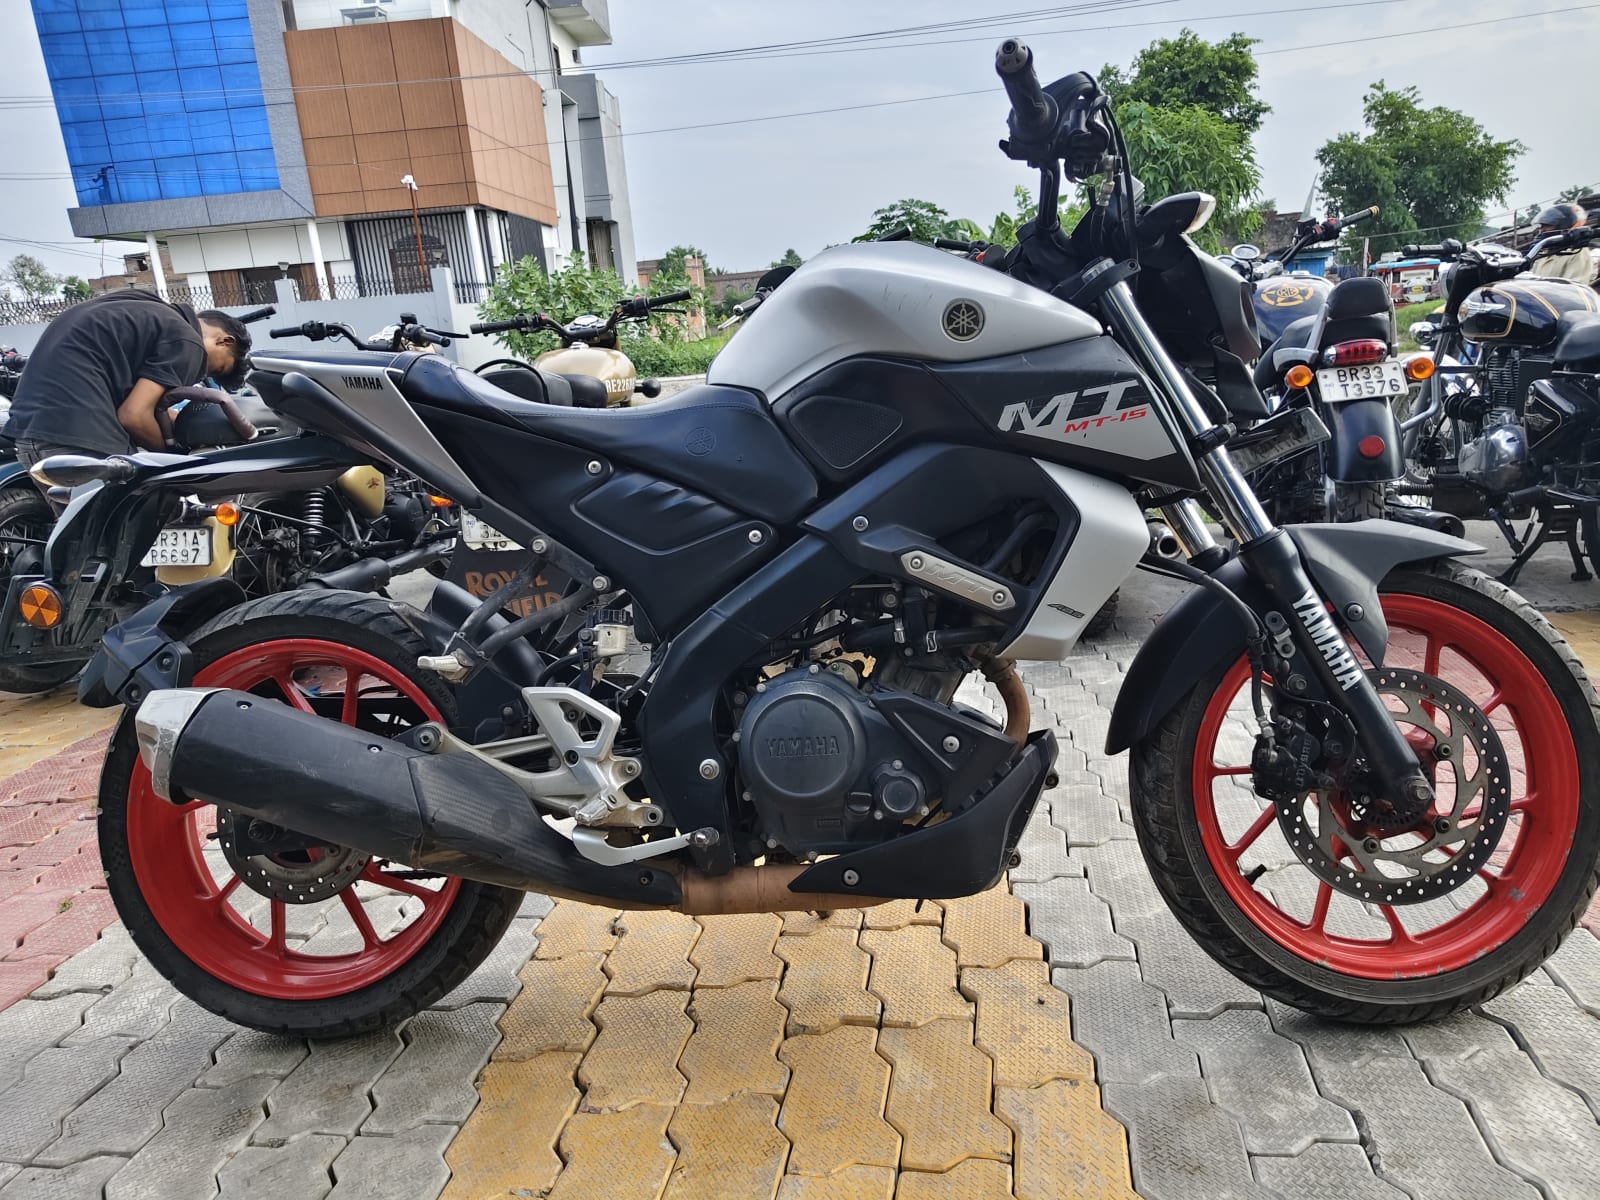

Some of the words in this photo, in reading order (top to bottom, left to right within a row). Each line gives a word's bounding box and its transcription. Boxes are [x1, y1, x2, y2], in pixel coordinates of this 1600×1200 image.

[341, 375, 383, 391] YAMAHA
[1336, 366, 1384, 383] BR33
[1341, 379, 1400, 397] T3576
[997, 379, 1139, 432] MT
[1063, 407, 1147, 434] MT-15
[1291, 588, 1363, 692] YAMAHA
[764, 735, 841, 757] YAMAHA
